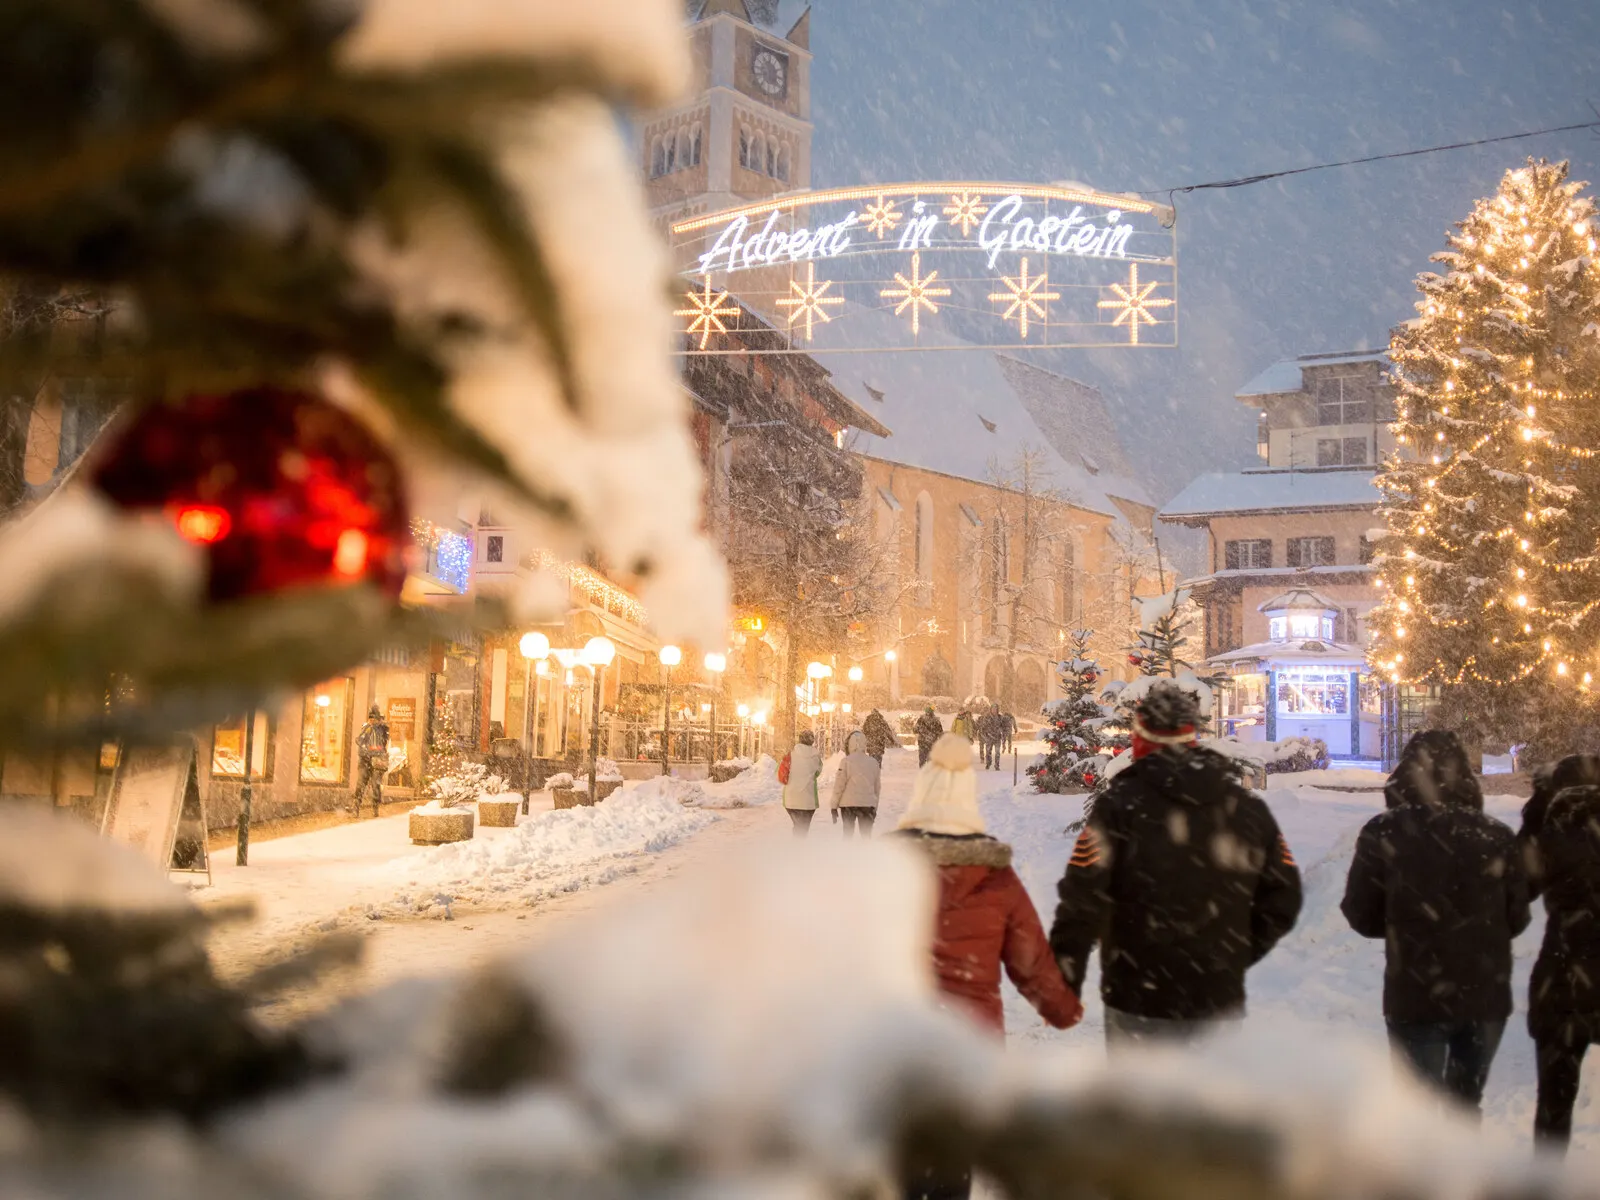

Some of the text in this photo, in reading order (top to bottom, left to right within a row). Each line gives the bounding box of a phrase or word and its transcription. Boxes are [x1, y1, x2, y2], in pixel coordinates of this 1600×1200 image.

[698, 194, 1133, 274] Advent in Gastein
